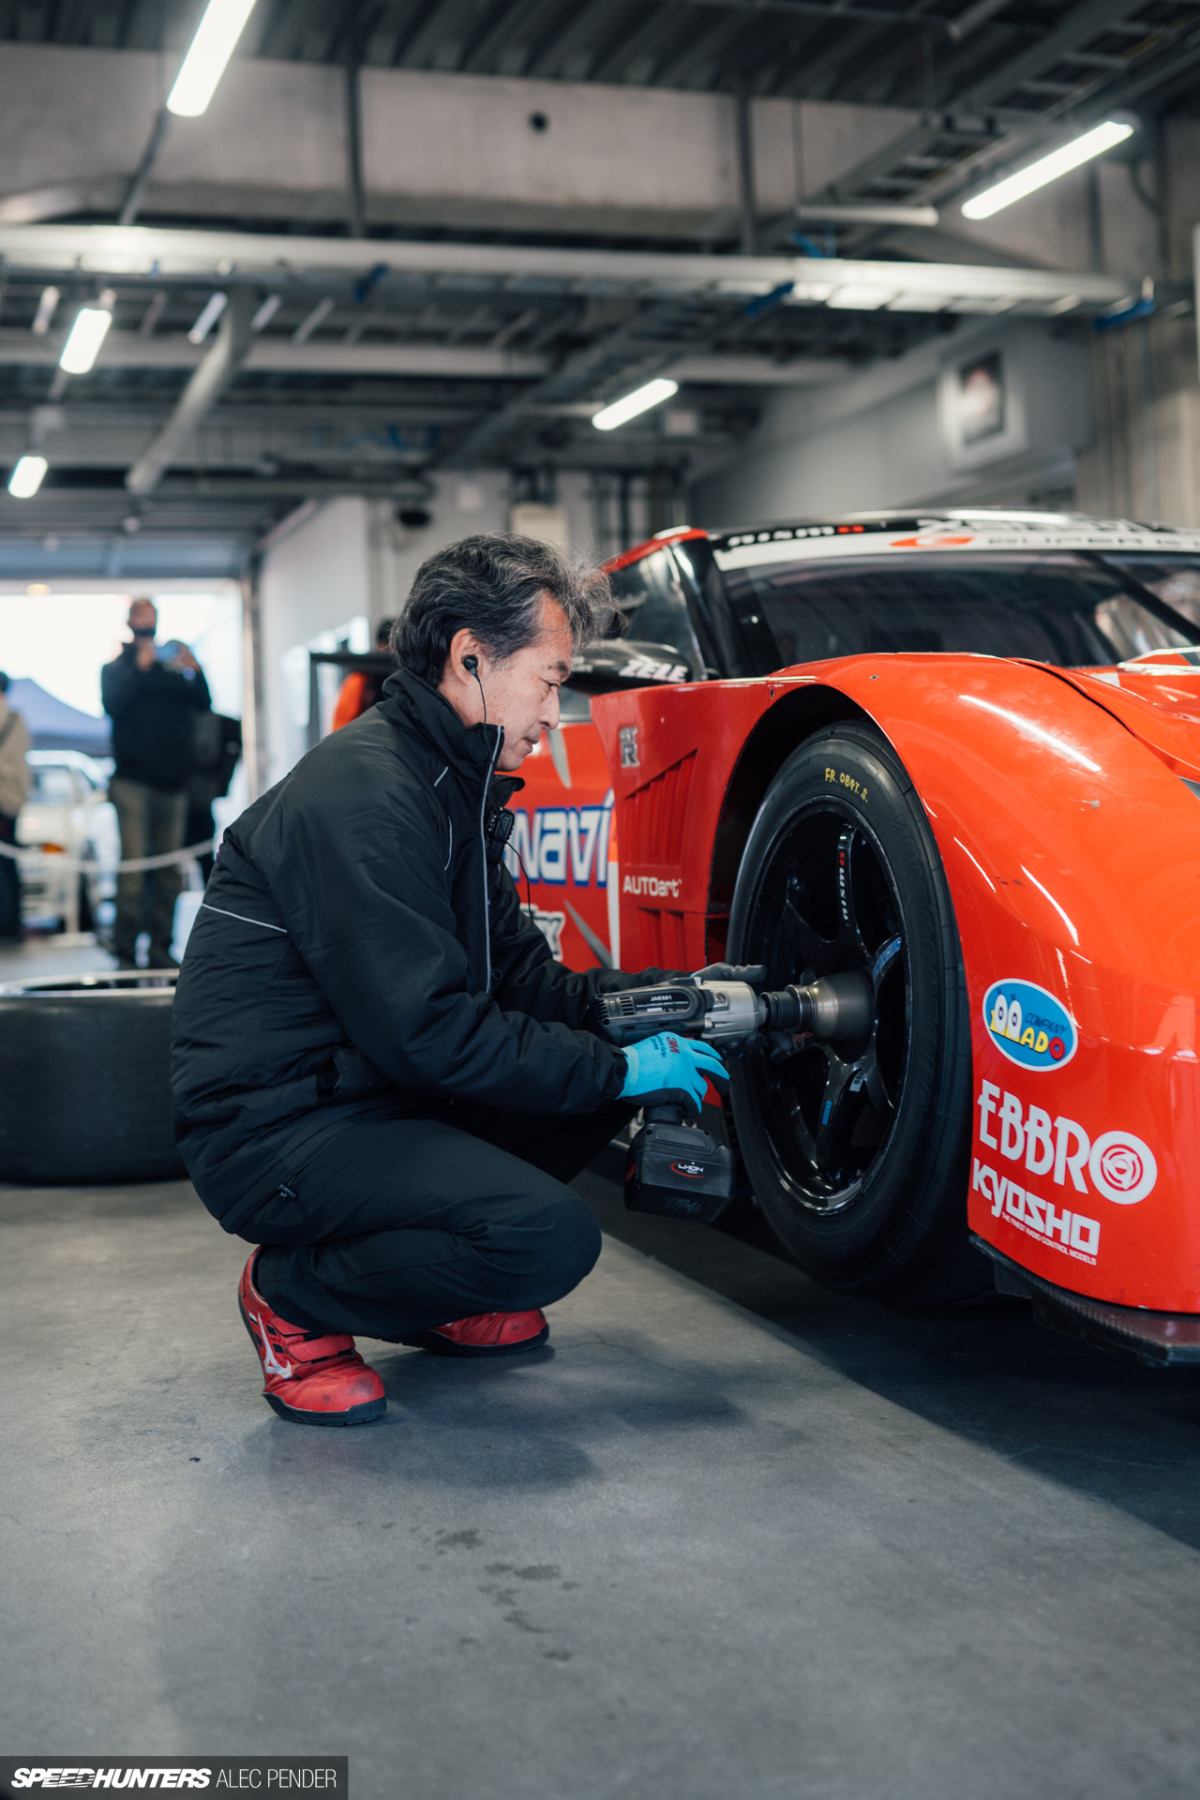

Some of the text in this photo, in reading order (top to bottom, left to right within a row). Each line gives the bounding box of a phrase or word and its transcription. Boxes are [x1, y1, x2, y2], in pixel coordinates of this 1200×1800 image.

[619, 659, 688, 683] ZELE
[667, 1036, 680, 1053] 3M
[977, 1079, 1157, 1205] EBBRO
